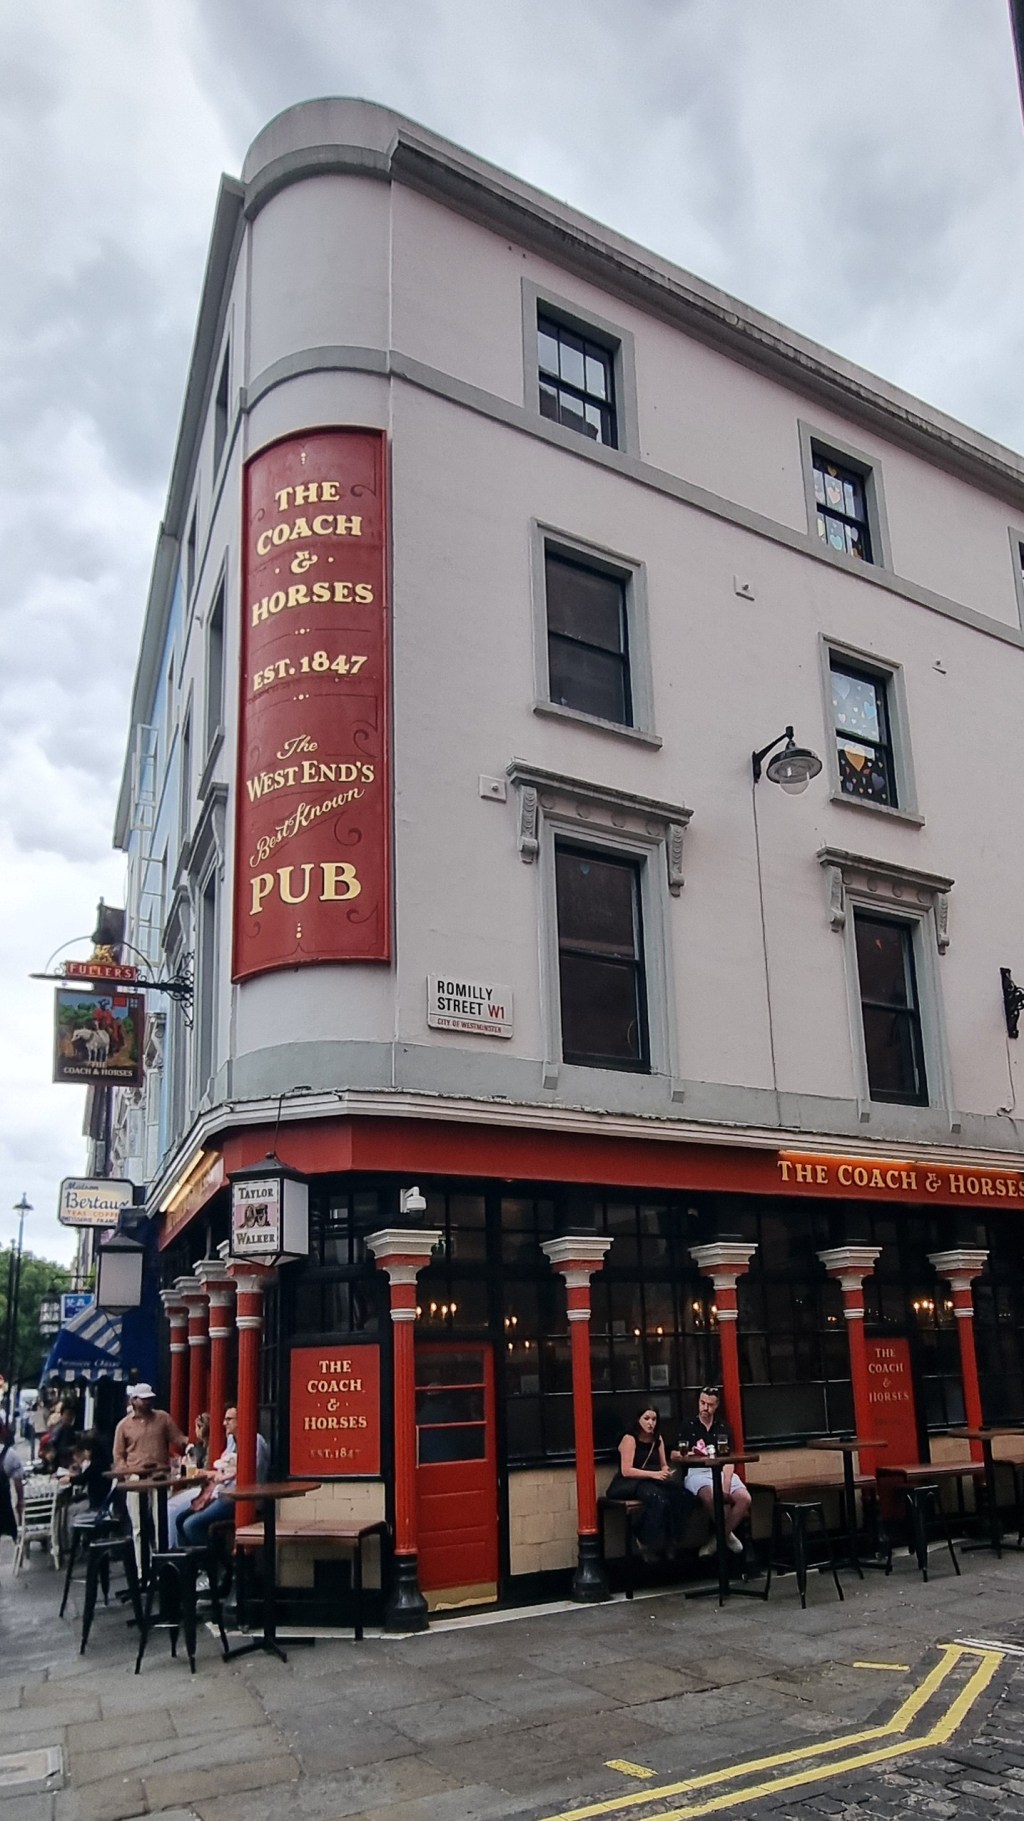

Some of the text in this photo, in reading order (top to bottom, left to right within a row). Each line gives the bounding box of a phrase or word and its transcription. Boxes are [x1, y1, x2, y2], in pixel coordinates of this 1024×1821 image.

[275, 481, 341, 512] THE
[256, 515, 362, 556] COACH
[290, 551, 319, 574] &
[251, 582, 375, 627] HORSES
[252, 650, 369, 692] EST. 1847
[277, 735, 319, 761] The
[246, 769, 300, 804] WEST
[249, 786, 366, 867] Best Known
[249, 861, 363, 917] PUB
[69, 963, 132, 978] FULLER'S
[437, 980, 493, 1001] ROMILLY
[437, 996, 505, 1020] STREET W1
[437, 1018, 502, 1034] CITY OF WESTMINSTER
[63, 1067, 91, 1075] COACH
[101, 1069, 133, 1077] HORSES
[777, 1160, 829, 1185] THE
[837, 1164, 917, 1191] COACH
[925, 1172, 942, 1193] &
[238, 1187, 274, 1201] TAYLOR
[235, 1231, 276, 1246] WALKER
[874, 1347, 896, 1359] THE
[318, 1359, 352, 1373] THE
[868, 1362, 904, 1374] COACH
[307, 1379, 362, 1393] COACH
[882, 1377, 892, 1388] &
[327, 1397, 340, 1411] &
[868, 1390, 910, 1403] HORSES
[304, 1416, 368, 1430] HORSES
